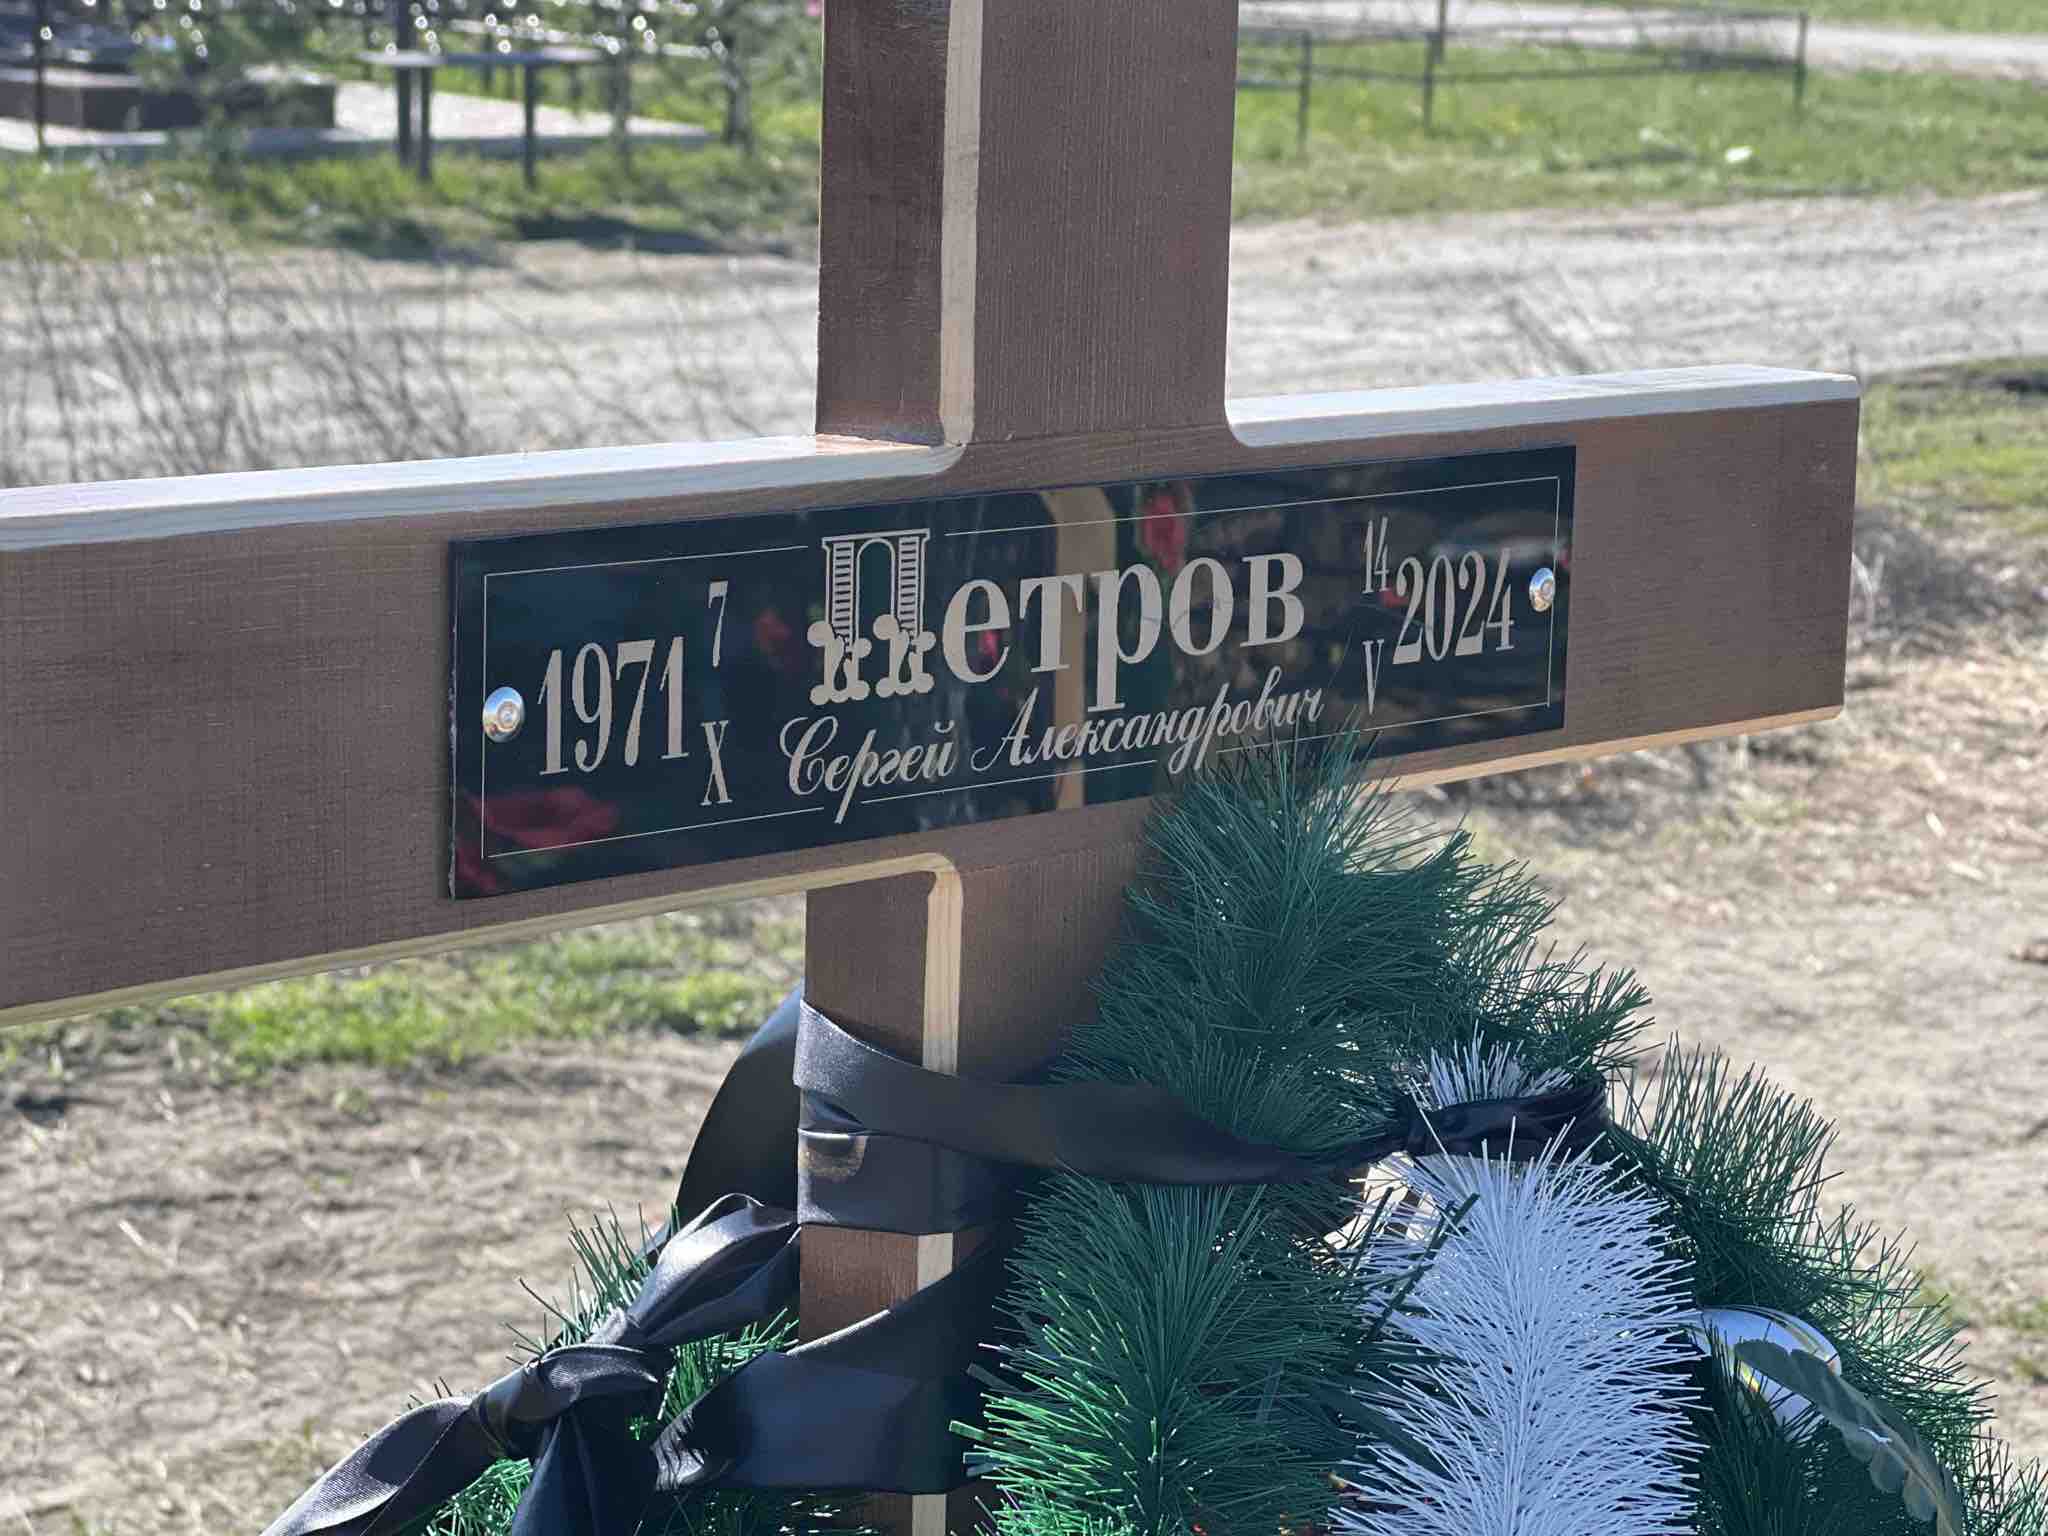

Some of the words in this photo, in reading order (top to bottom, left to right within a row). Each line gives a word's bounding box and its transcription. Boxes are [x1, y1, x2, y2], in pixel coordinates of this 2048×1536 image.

[1362, 516, 1390, 594] 14
[1392, 547, 1516, 666] 2024
[707, 580, 729, 668] 7
[807, 528, 1305, 712] Петров
[1361, 639, 1386, 715] V
[536, 636, 689, 776] 1971
[779, 716, 956, 824] Сергей
[971, 666, 1325, 774] Александрович
